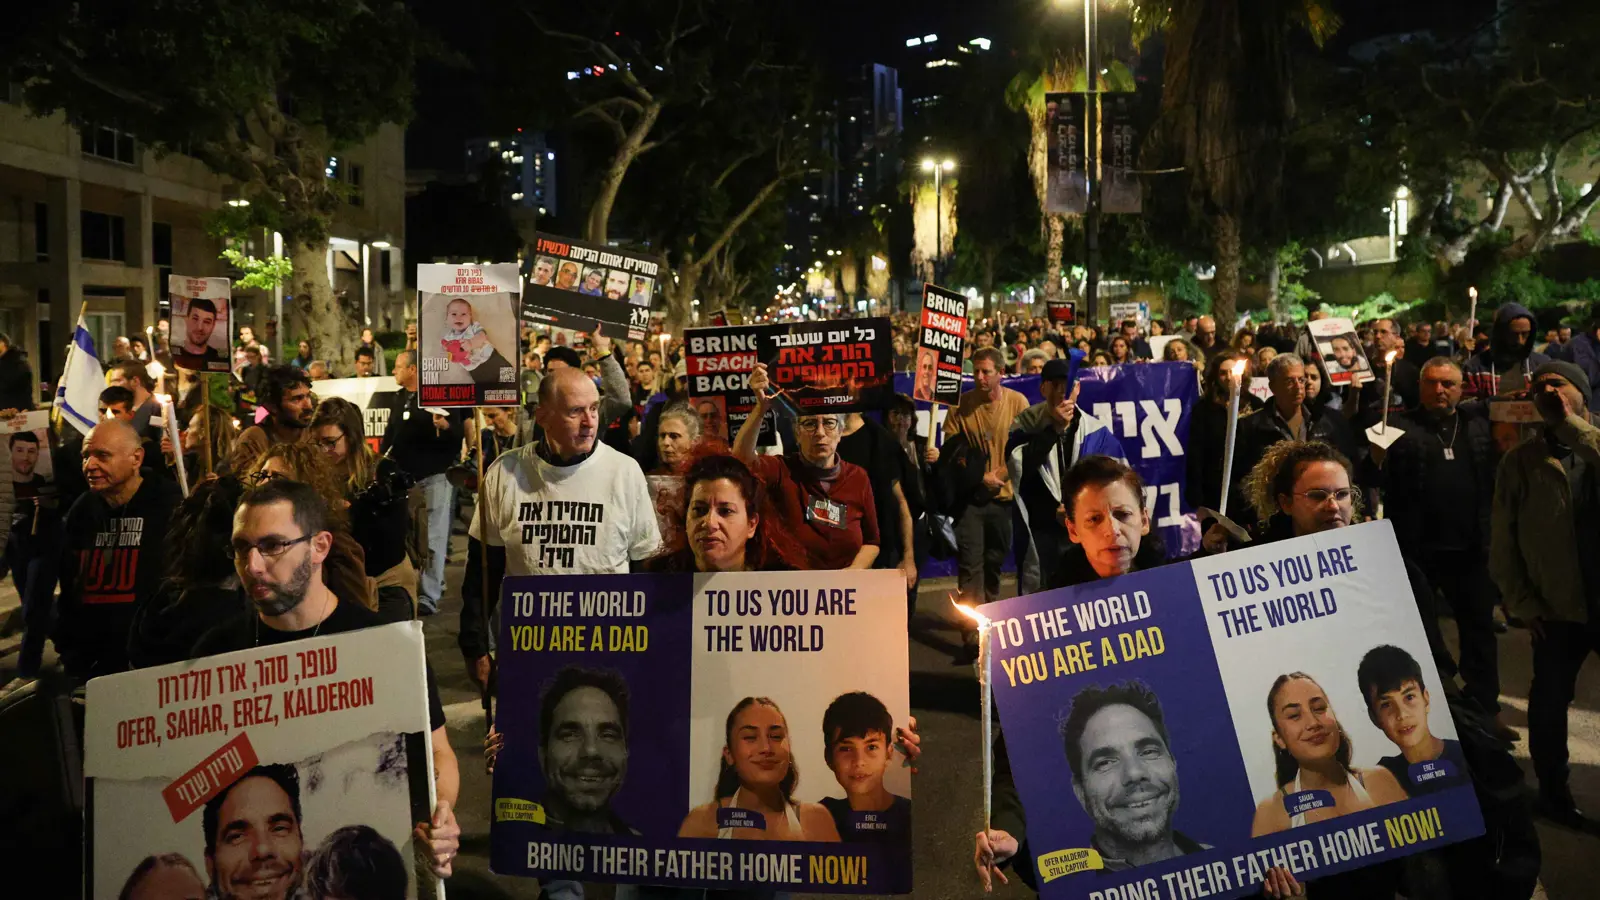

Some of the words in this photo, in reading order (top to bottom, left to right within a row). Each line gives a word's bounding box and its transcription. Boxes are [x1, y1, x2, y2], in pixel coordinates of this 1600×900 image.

[569, 246, 599, 262] הביתה
[598, 251, 623, 268] אותם
[624, 257, 659, 275] מחזירים
[455, 276, 467, 284] KFIR
[468, 276, 484, 284] BIBAS
[926, 291, 965, 317] BRING
[854, 326, 876, 341] כל
[927, 312, 962, 333] TSACHI
[770, 332, 823, 347] שעובר
[828, 330, 850, 343] יום
[924, 328, 961, 352] BACK!
[696, 355, 758, 372] TSACH
[778, 346, 815, 365] את
[821, 343, 872, 362] הורג
[422, 357, 449, 371] BRING
[776, 361, 876, 383] החטופים
[422, 371, 440, 385] HIM
[422, 386, 447, 400] HOME
[449, 384, 475, 400] NOW!
[518, 502, 543, 521] את
[547, 501, 603, 523] תחזירו
[119, 532, 142, 546] אותם
[522, 524, 596, 545] החטופים
[539, 545, 574, 568] מיד!
[1207, 571, 1238, 601] TO
[1239, 564, 1269, 595] US
[1269, 554, 1313, 588] YOU
[1316, 544, 1358, 578] ARE
[512, 591, 532, 618] TO
[538, 591, 575, 617] THE
[579, 591, 646, 617] WORLD
[704, 590, 730, 617] TO
[736, 589, 762, 616] US
[767, 589, 809, 616] YOU
[814, 588, 857, 616] ARE
[1217, 604, 1262, 638] THE
[1262, 587, 1338, 628] WORLD
[992, 617, 1024, 650] TO
[1025, 607, 1072, 642] THE
[1072, 590, 1152, 632] WORLD
[510, 625, 545, 652] YOU
[549, 625, 587, 651] ARE
[590, 625, 603, 651] A
[608, 625, 649, 652] DAD
[704, 625, 745, 652] THE
[749, 625, 824, 652] WORLD
[294, 646, 338, 686] עופר,
[1001, 651, 1049, 688] YOU
[1052, 641, 1098, 677] ARE
[1101, 637, 1118, 667] A
[1118, 626, 1166, 662] DAD
[217, 662, 248, 695] ארז
[251, 659, 288, 693] סהר,
[157, 669, 213, 709] קלדרון
[117, 716, 162, 749] OFER,
[166, 701, 229, 740] SAHAR,
[233, 694, 279, 728] EREZ,
[283, 677, 374, 719] KALDERON
[207, 747, 245, 790] עדיין
[176, 776, 210, 807] שבוי
[1298, 793, 1315, 803] SAHAR
[1299, 802, 1312, 812] HOME
[1312, 800, 1323, 808] NOW
[527, 842, 585, 873] BRING
[589, 845, 648, 877] THEIR
[654, 848, 733, 881] FATHER
[739, 853, 802, 883] HOME
[809, 854, 868, 885] NOW!
[1044, 857, 1059, 867] OFER
[1060, 850, 1090, 863] KALDERON
[1162, 861, 1233, 900] THEIR
[1318, 822, 1385, 865] HOME
[1384, 807, 1445, 849] NOW!
[1049, 866, 1065, 877] STILL
[1065, 860, 1089, 872] CAPTIVE
